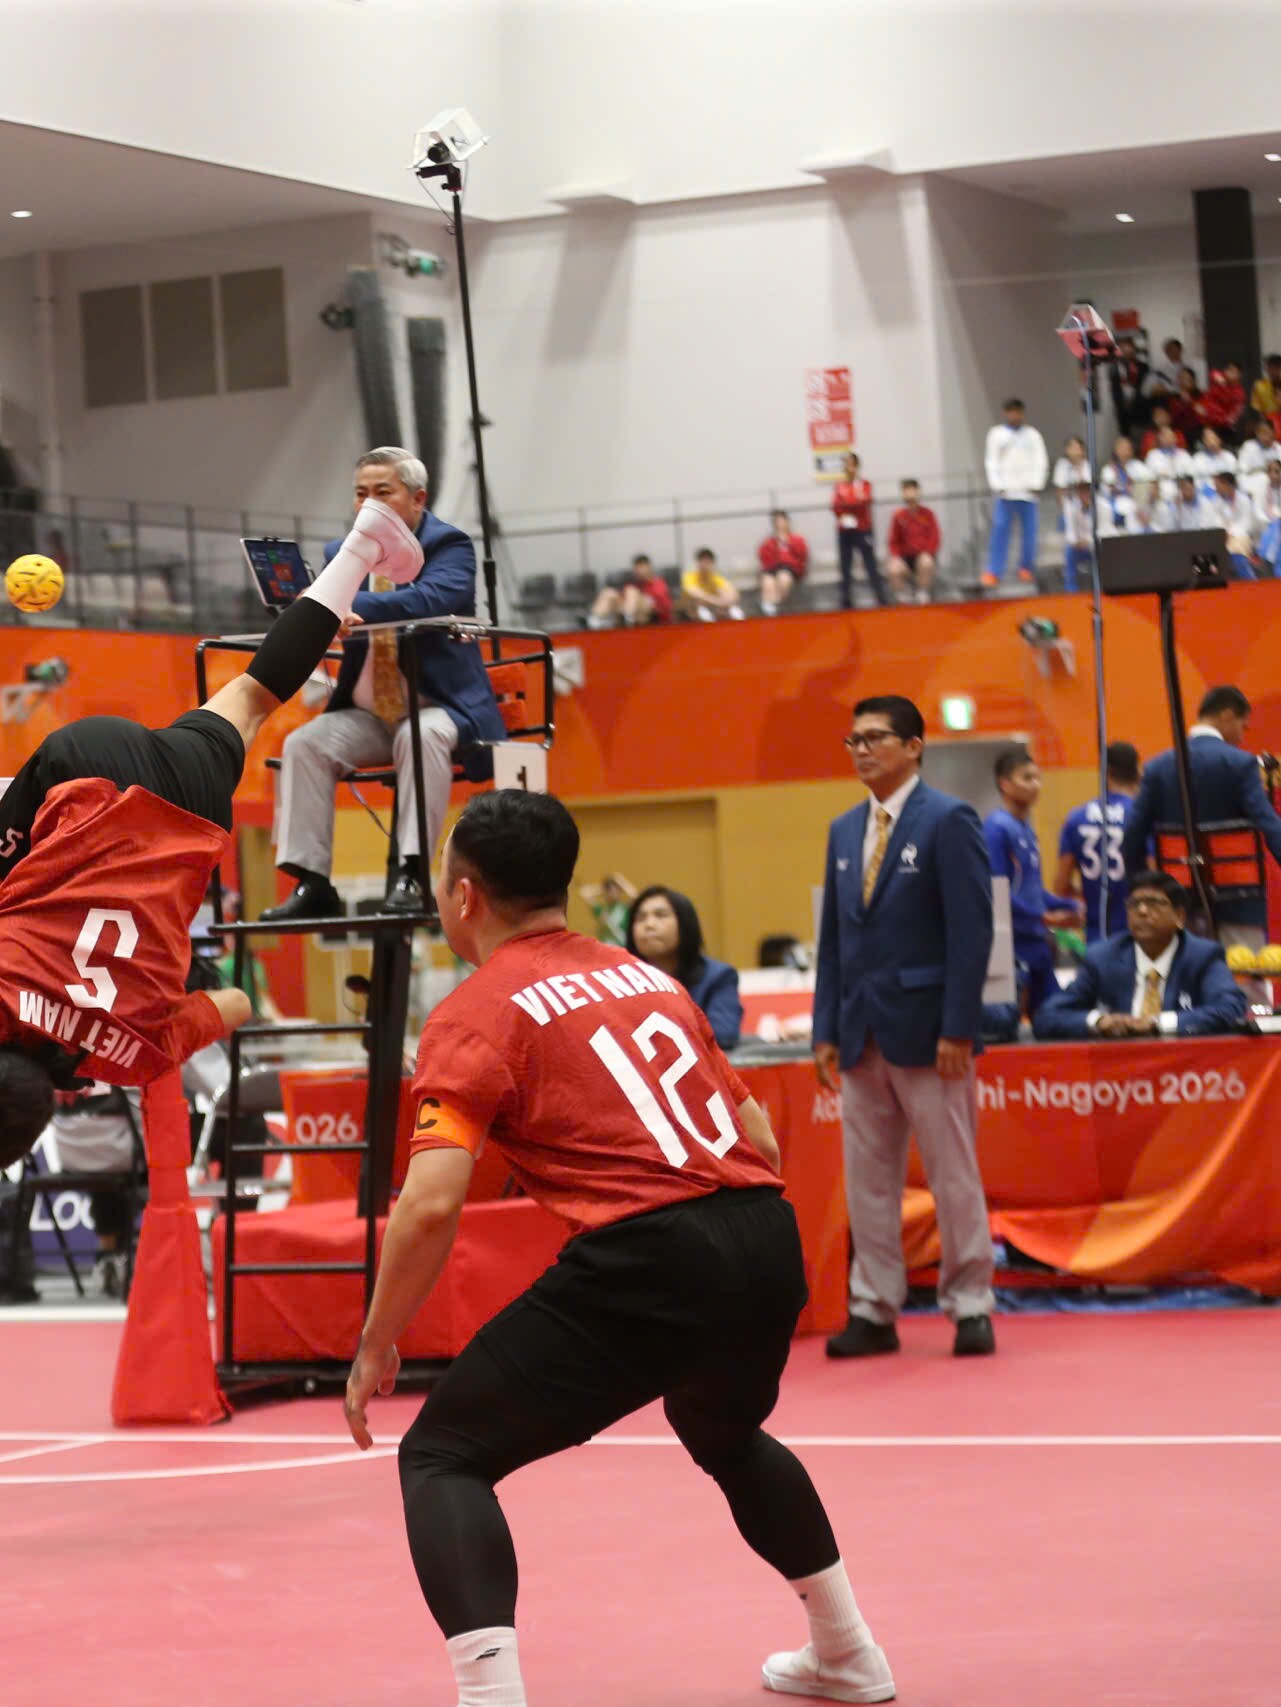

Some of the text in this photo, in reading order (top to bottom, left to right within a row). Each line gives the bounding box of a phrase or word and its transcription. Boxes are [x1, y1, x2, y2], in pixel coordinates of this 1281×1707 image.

[1078, 825, 1125, 881] 33
[65, 908, 139, 1013] 5
[510, 961, 679, 1026] VIET NAM
[19, 990, 143, 1069] VIET NAM
[416, 1097, 440, 1130] C
[588, 1011, 739, 1168] 12
[1160, 1068, 1246, 1104] 2026
